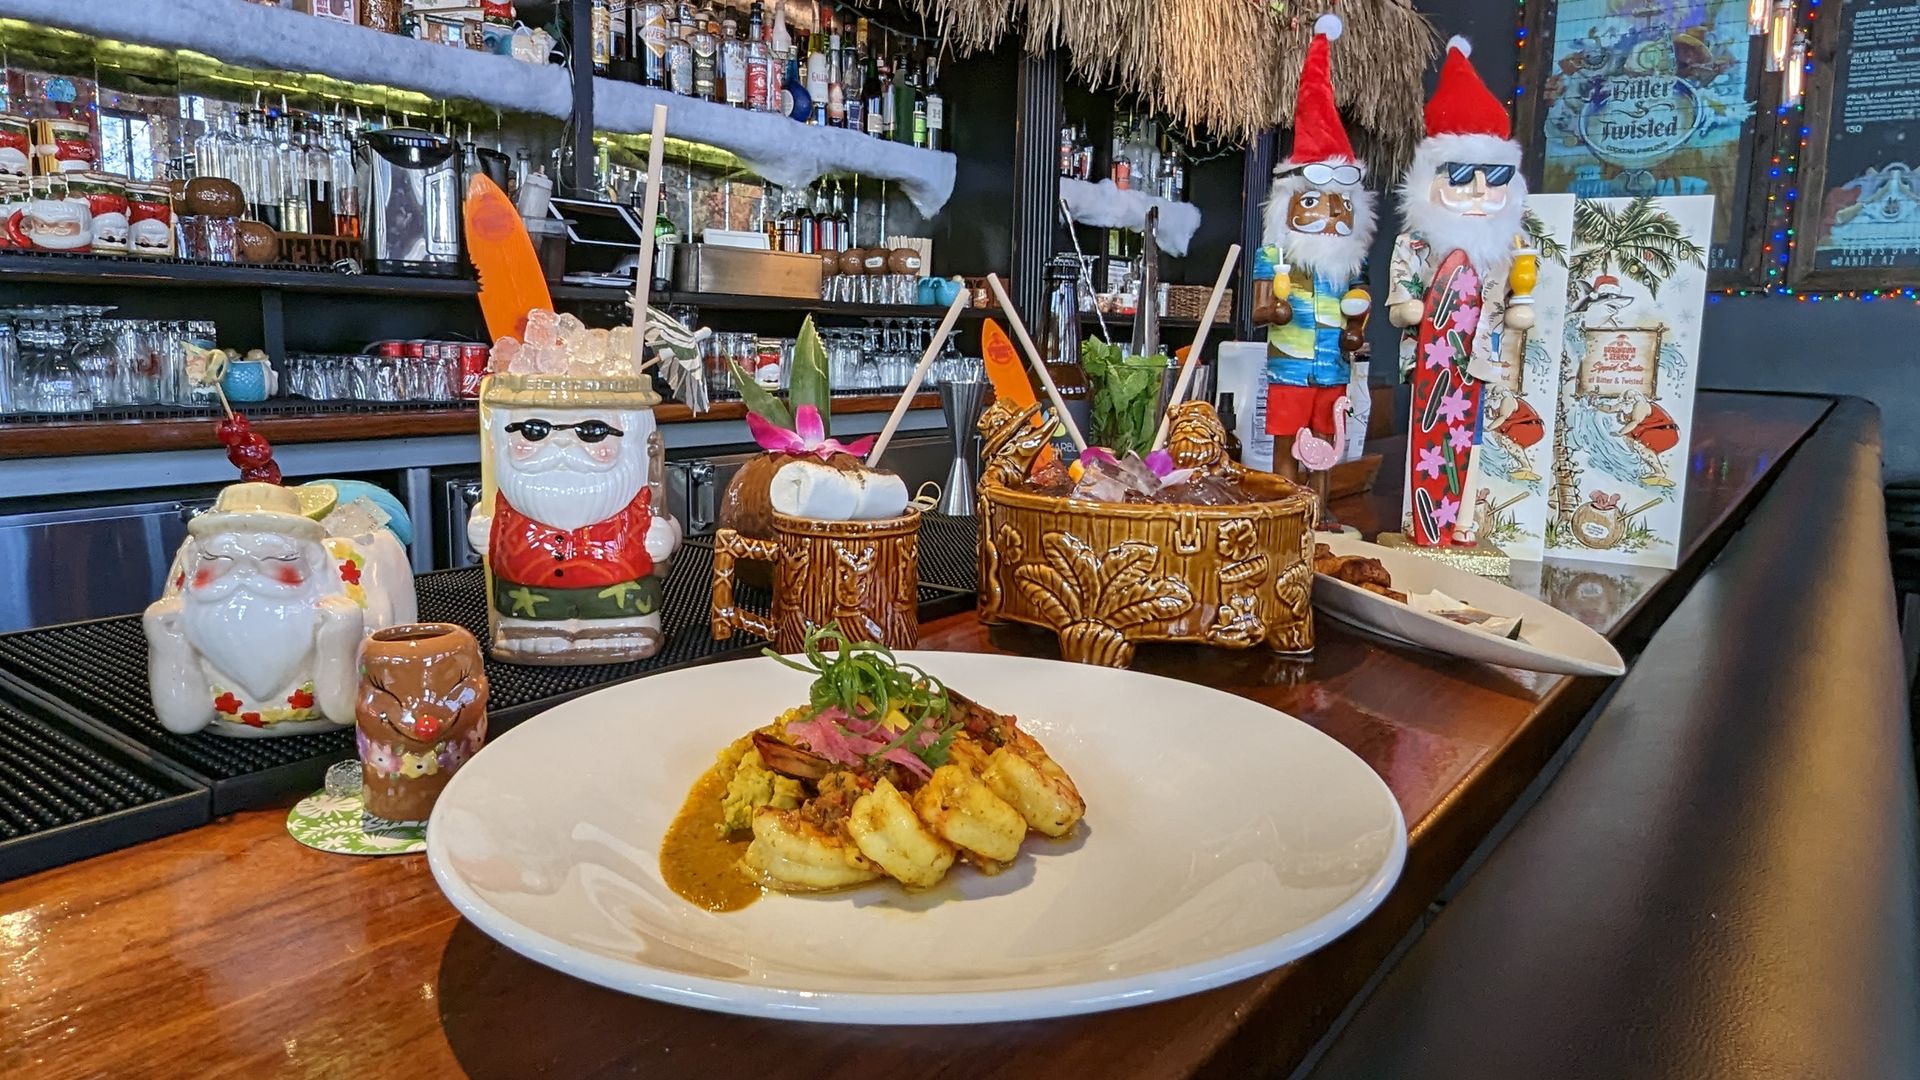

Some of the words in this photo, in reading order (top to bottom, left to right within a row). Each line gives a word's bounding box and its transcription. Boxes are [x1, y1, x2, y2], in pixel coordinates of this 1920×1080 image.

[1609, 79, 1675, 102] Bitter
[1599, 116, 1679, 142] Twisted
[1596, 376, 1613, 384] Bitter
[1621, 376, 1644, 385] Twisted
